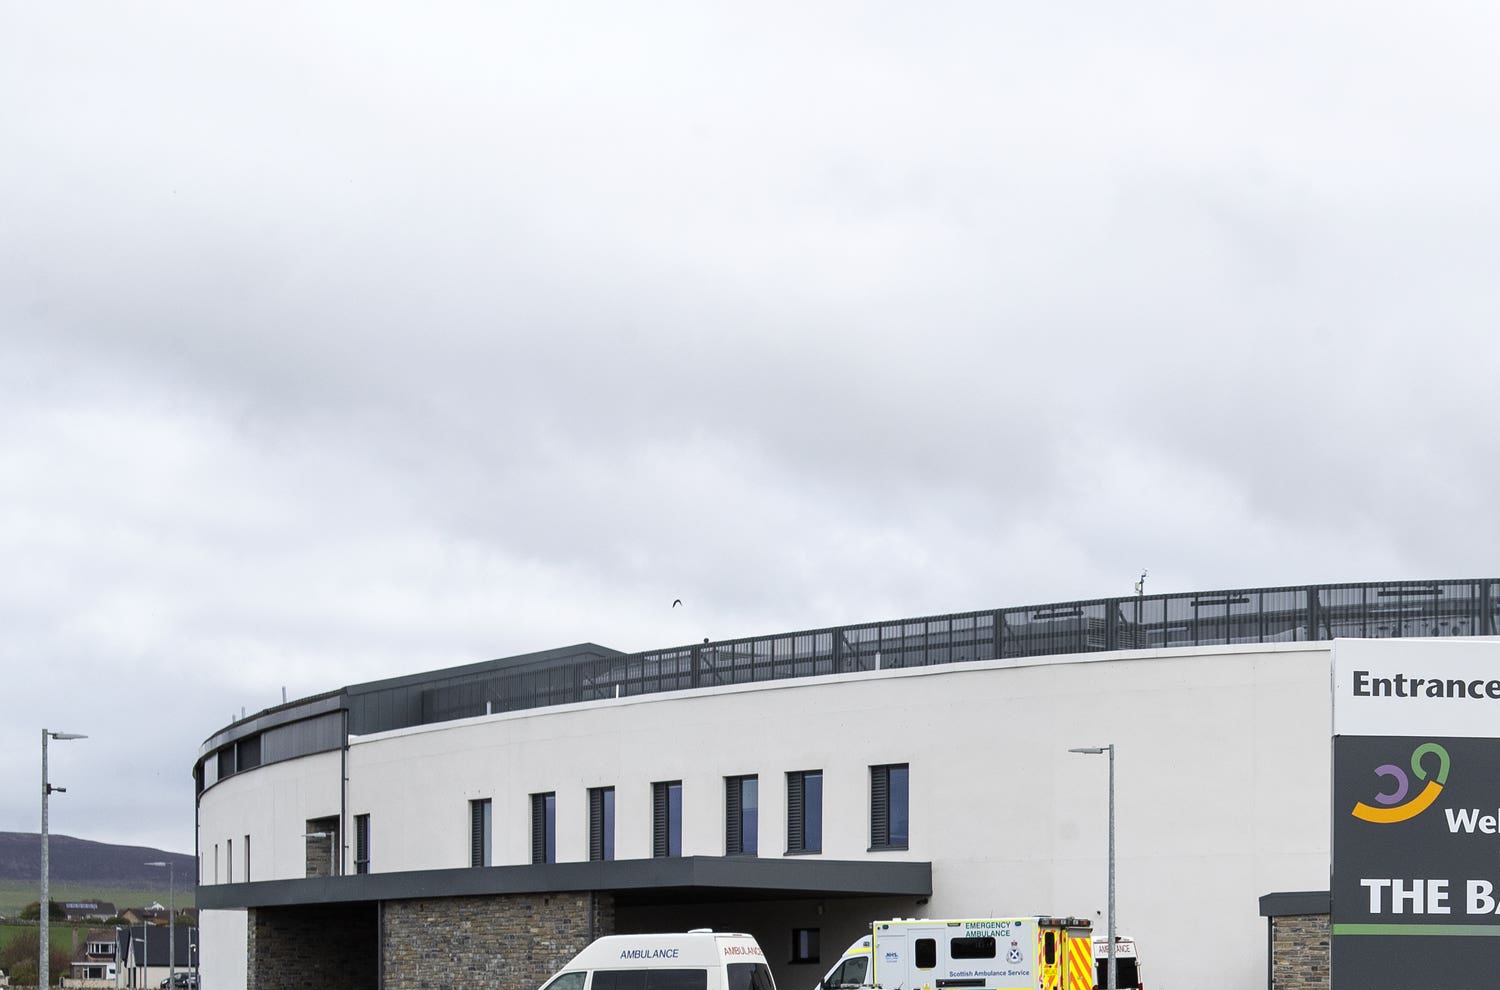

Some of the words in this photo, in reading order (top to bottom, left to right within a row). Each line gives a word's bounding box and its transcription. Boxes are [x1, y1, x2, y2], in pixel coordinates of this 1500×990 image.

[1361, 879, 1450, 914] THE
[965, 929, 1011, 937] AMBULANCE
[1099, 945, 1130, 953] AMBANCE
[620, 949, 679, 959] AMBULANCE
